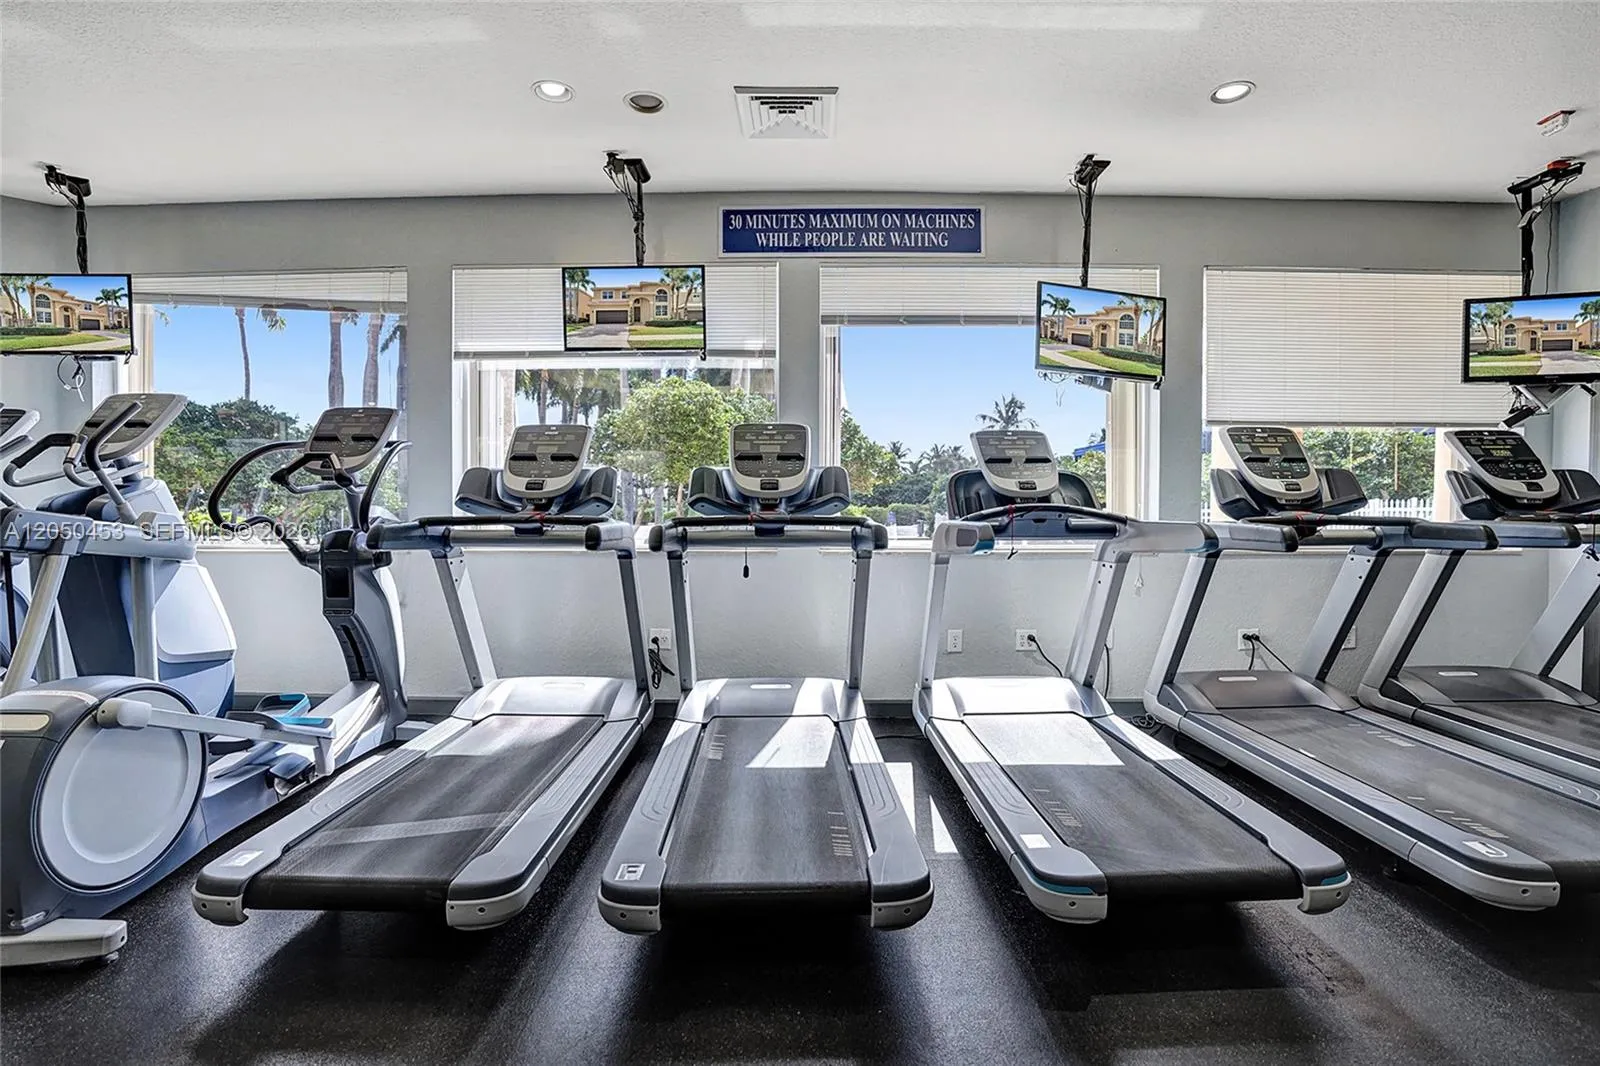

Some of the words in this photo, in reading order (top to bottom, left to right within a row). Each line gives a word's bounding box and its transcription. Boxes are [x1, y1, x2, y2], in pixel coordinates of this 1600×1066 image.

[728, 214, 743, 230] 30
[745, 213, 806, 229] MINUTES
[808, 213, 878, 229] MAXIMUM
[881, 213, 901, 229] ON
[904, 213, 975, 229] MACHINES
[755, 232, 801, 247] WHILE
[804, 231, 856, 247] PEOPLE
[859, 231, 886, 247] ARE
[890, 231, 949, 247] WAITING
